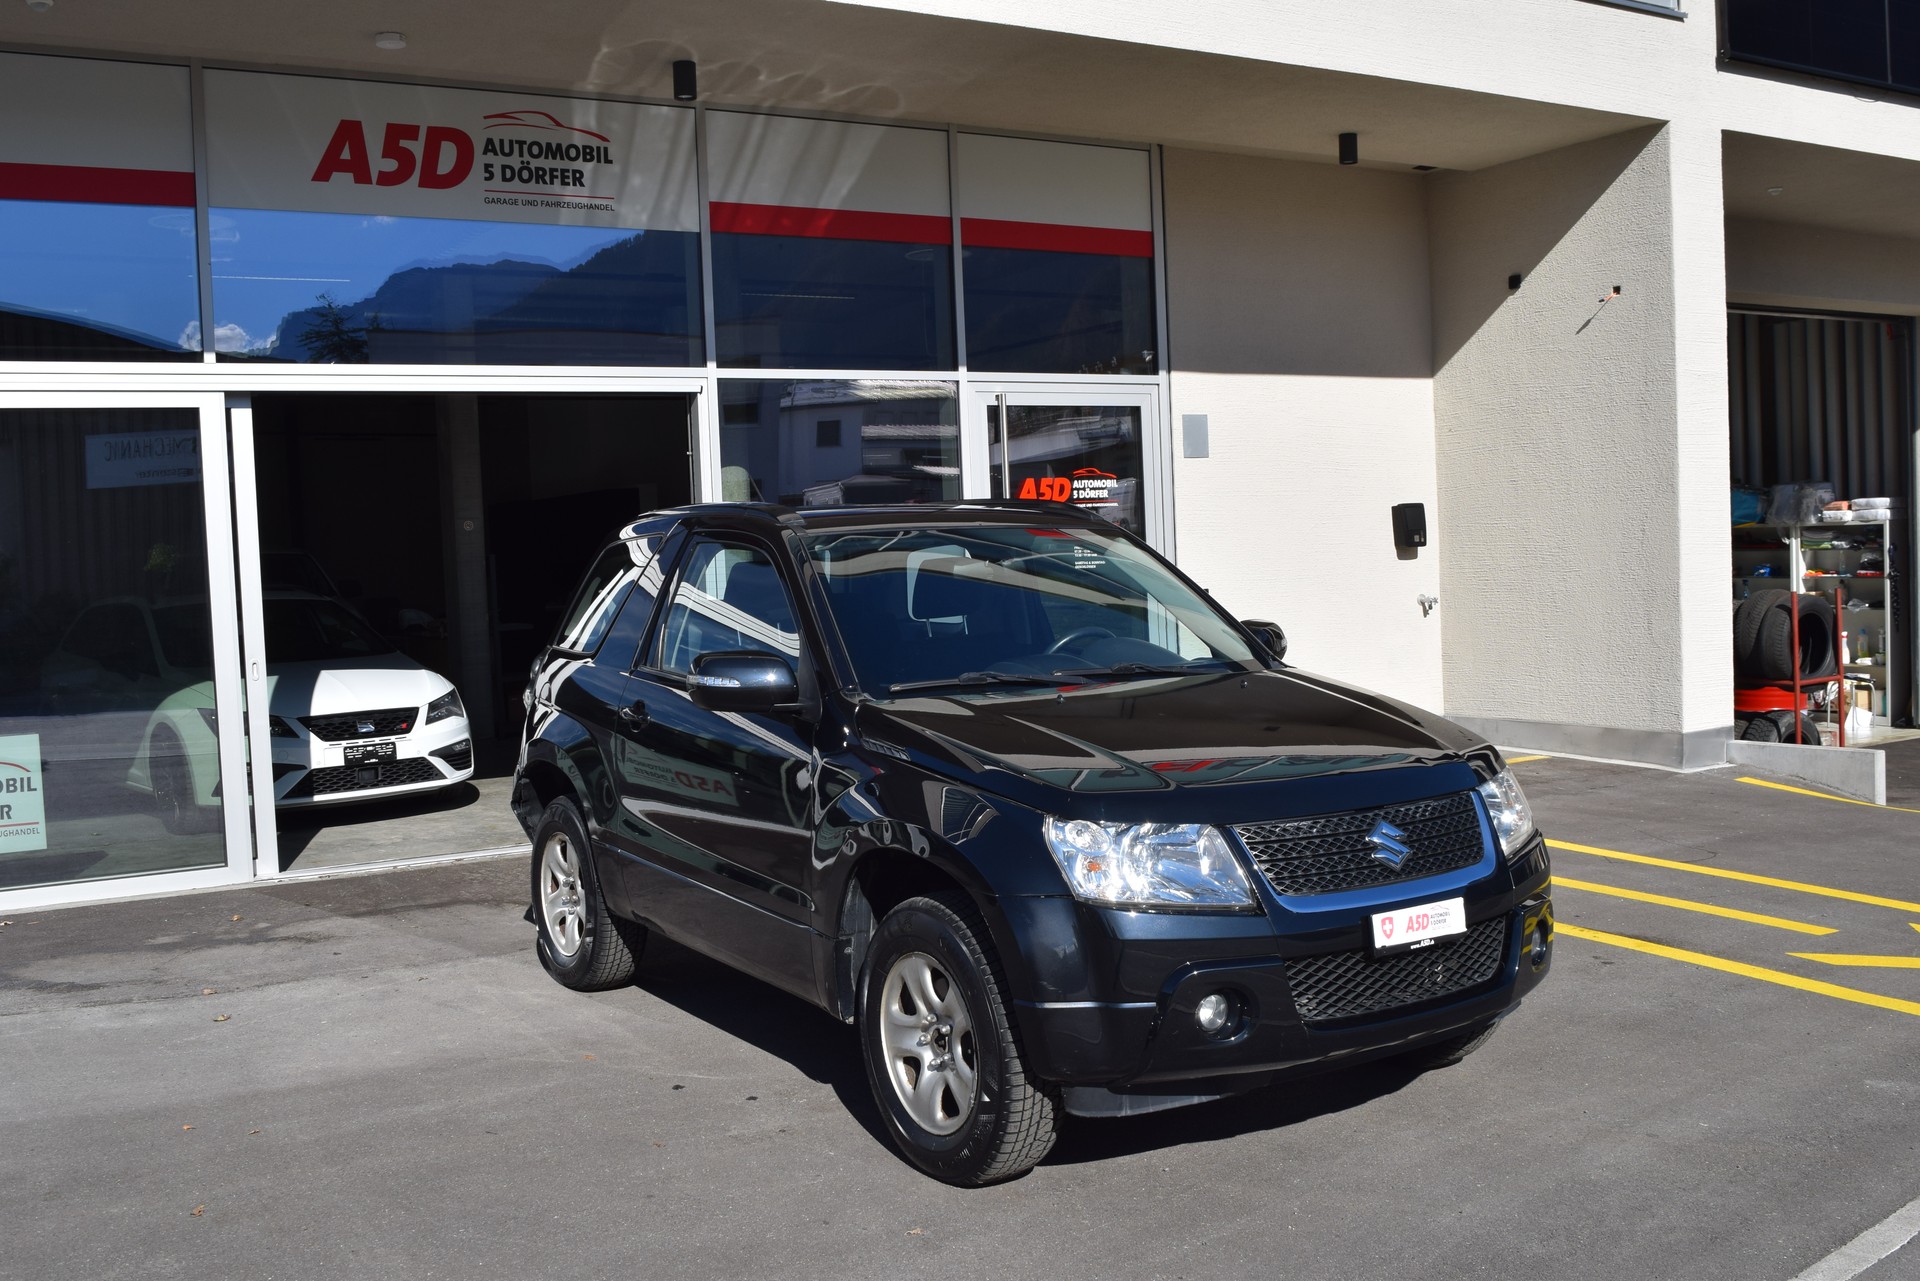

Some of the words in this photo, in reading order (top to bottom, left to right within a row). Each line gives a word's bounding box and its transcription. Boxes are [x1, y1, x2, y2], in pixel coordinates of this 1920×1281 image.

[311, 118, 475, 190] A5D
[482, 137, 614, 165] AUTOMOBIL
[483, 164, 495, 182] 5
[501, 160, 586, 188] DÖRFER
[484, 196, 520, 207] GARAGE
[521, 198, 539, 208] UND
[540, 200, 616, 212] FAHRZEUGHANDEL
[1019, 477, 1072, 503] A5D
[1073, 479, 1118, 489] AUTOMOBIL
[1079, 488, 1109, 499] DÖRFER
[1406, 913, 1430, 934] A5D
